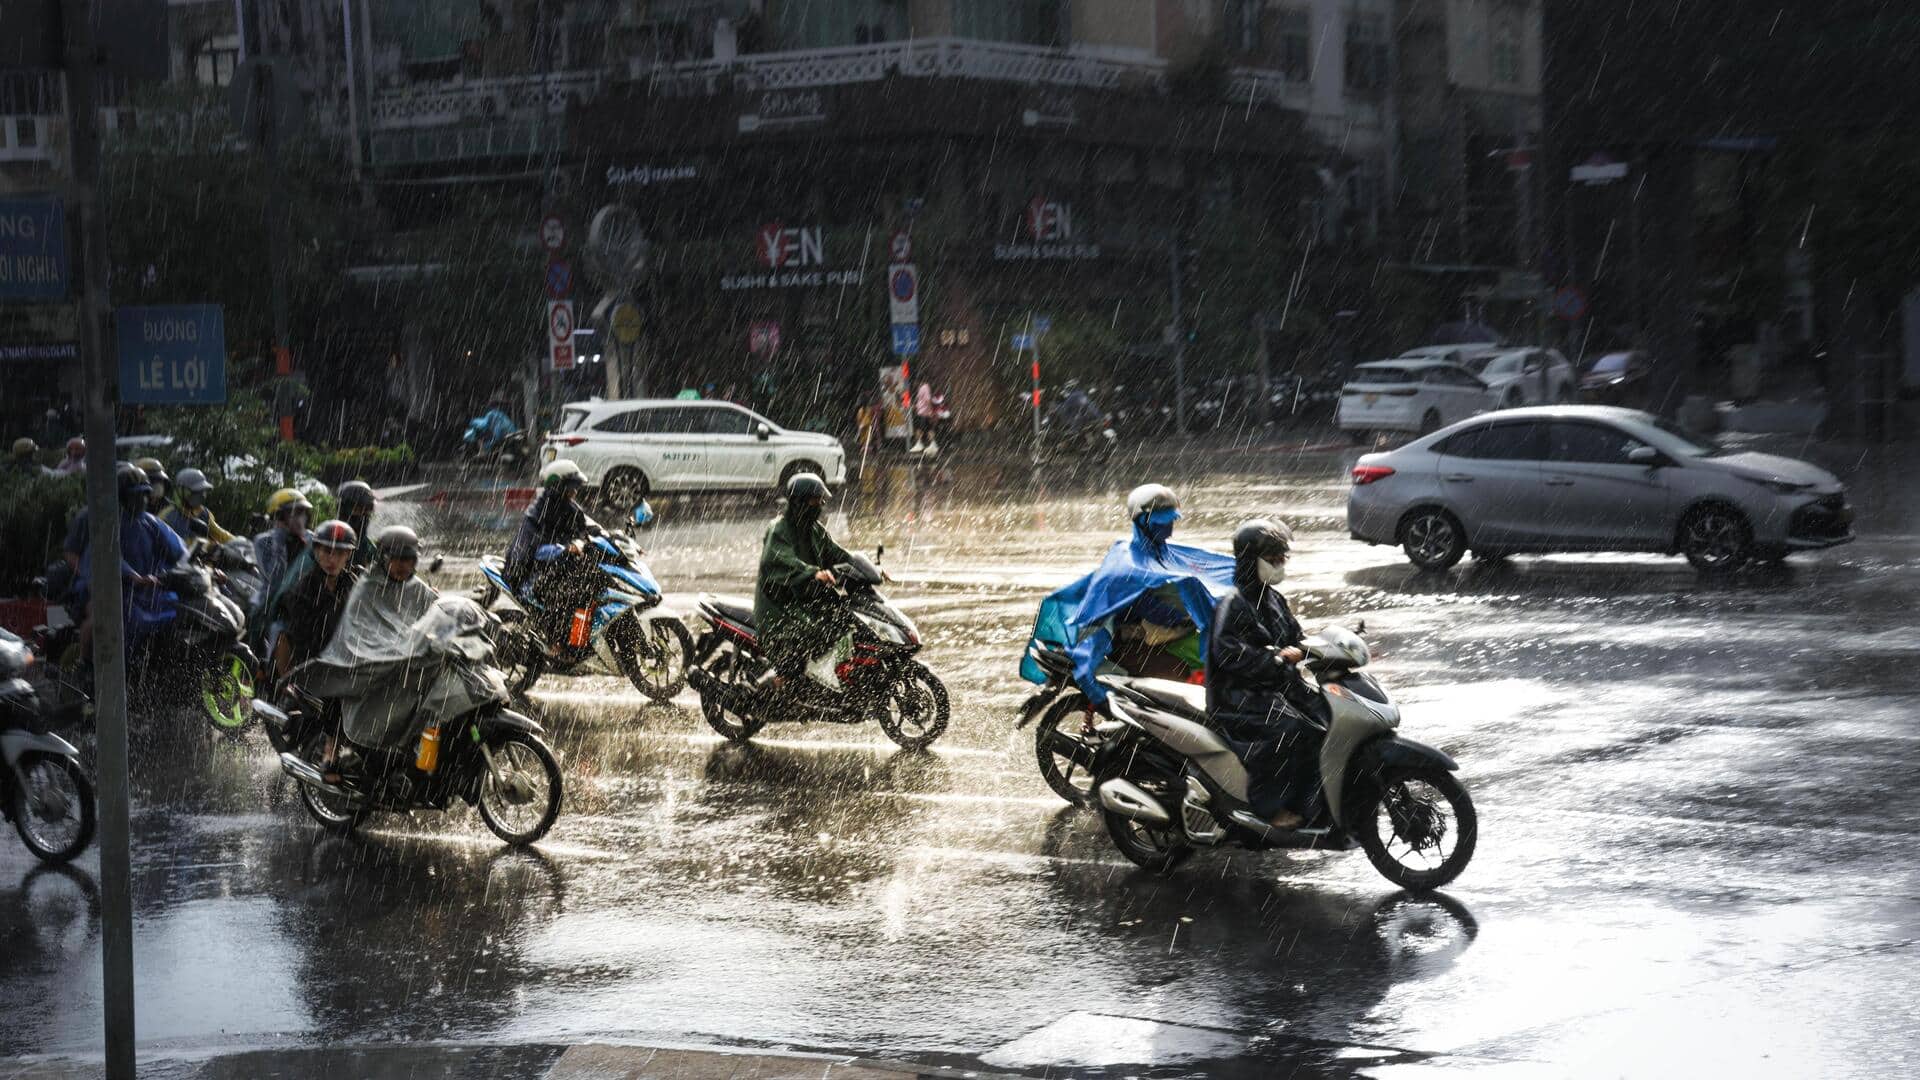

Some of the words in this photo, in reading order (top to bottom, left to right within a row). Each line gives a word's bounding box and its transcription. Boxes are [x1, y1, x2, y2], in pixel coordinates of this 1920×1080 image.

[780, 273, 823, 288] SAKE
[826, 271, 860, 286] PUB
[0, 346, 27, 360] TNAM
[139, 353, 165, 389] LÊ
[171, 354, 207, 397] LỢI
